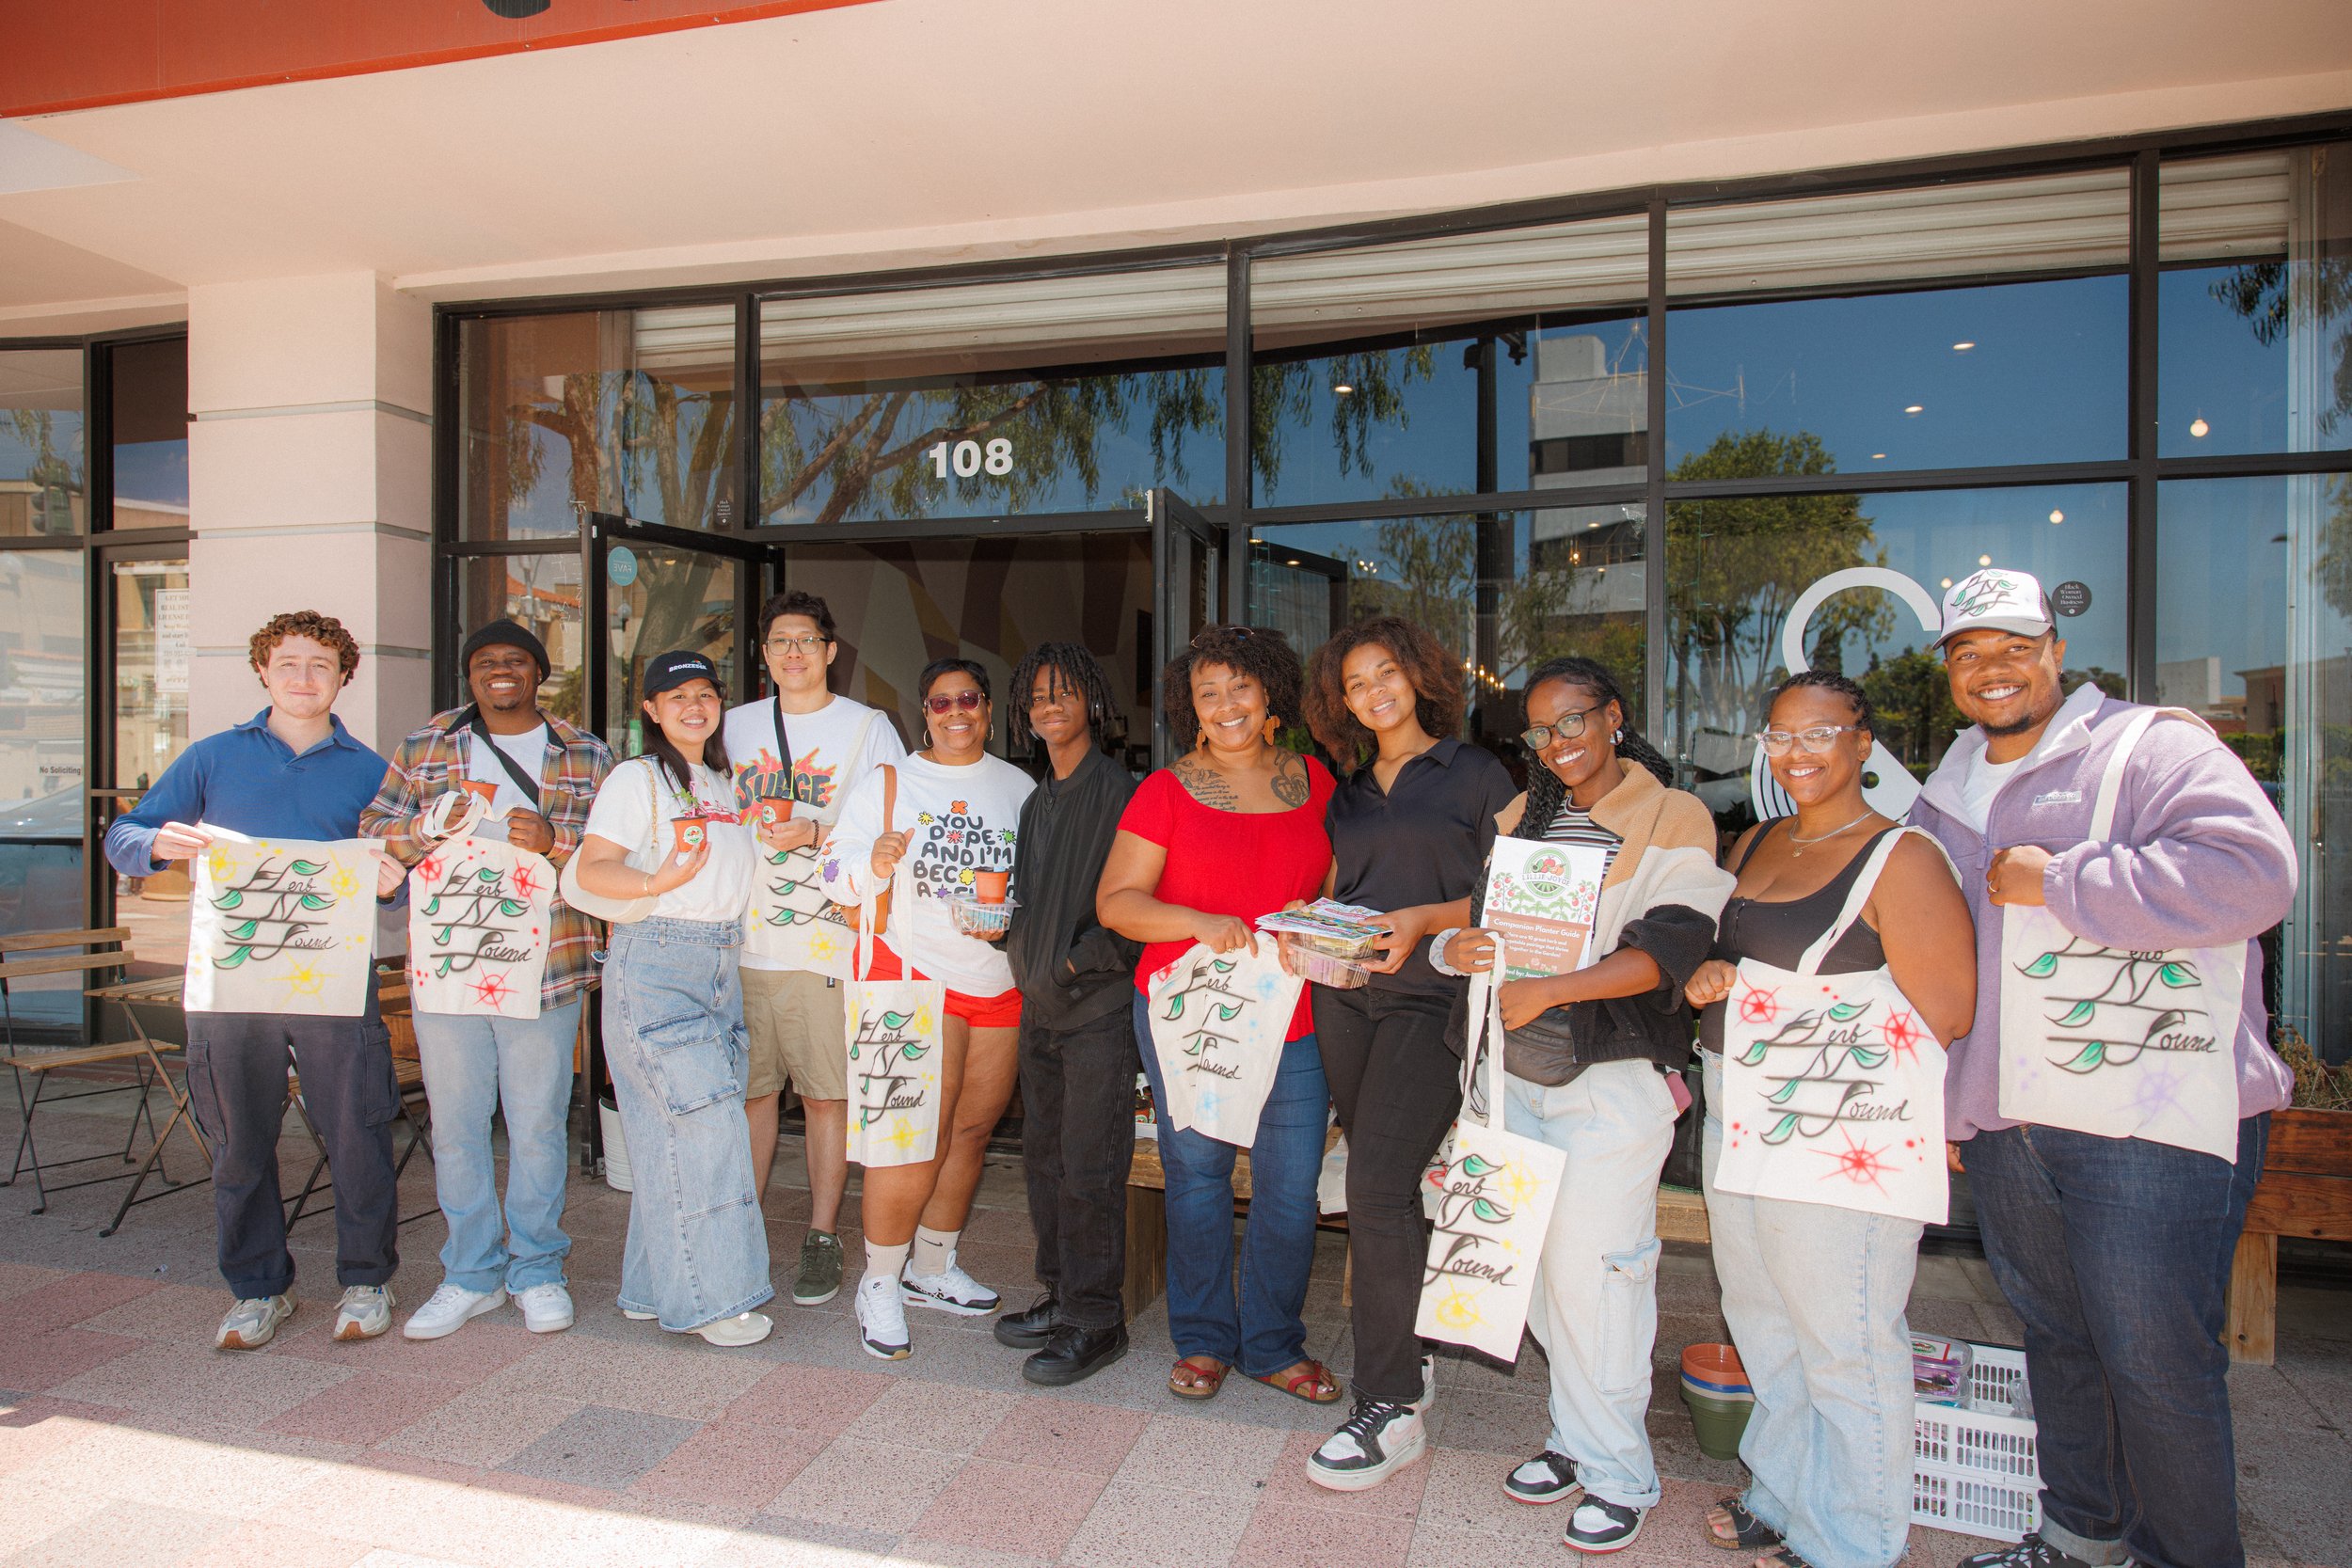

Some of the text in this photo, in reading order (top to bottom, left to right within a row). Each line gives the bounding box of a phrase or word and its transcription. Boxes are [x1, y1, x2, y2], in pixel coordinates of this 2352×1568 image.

[930, 438, 1013, 478] 108
[50, 766, 81, 775] Soliciting
[937, 814, 983, 830] YOU
[921, 842, 1012, 866] AND I'M
[226, 857, 325, 894] Herb
[435, 861, 507, 897] Herb
[917, 881, 931, 897] A
[1494, 918, 1580, 938] Companion Planter Guide
[856, 1009, 911, 1042] Herb
[1761, 1000, 1873, 1045] Herb
